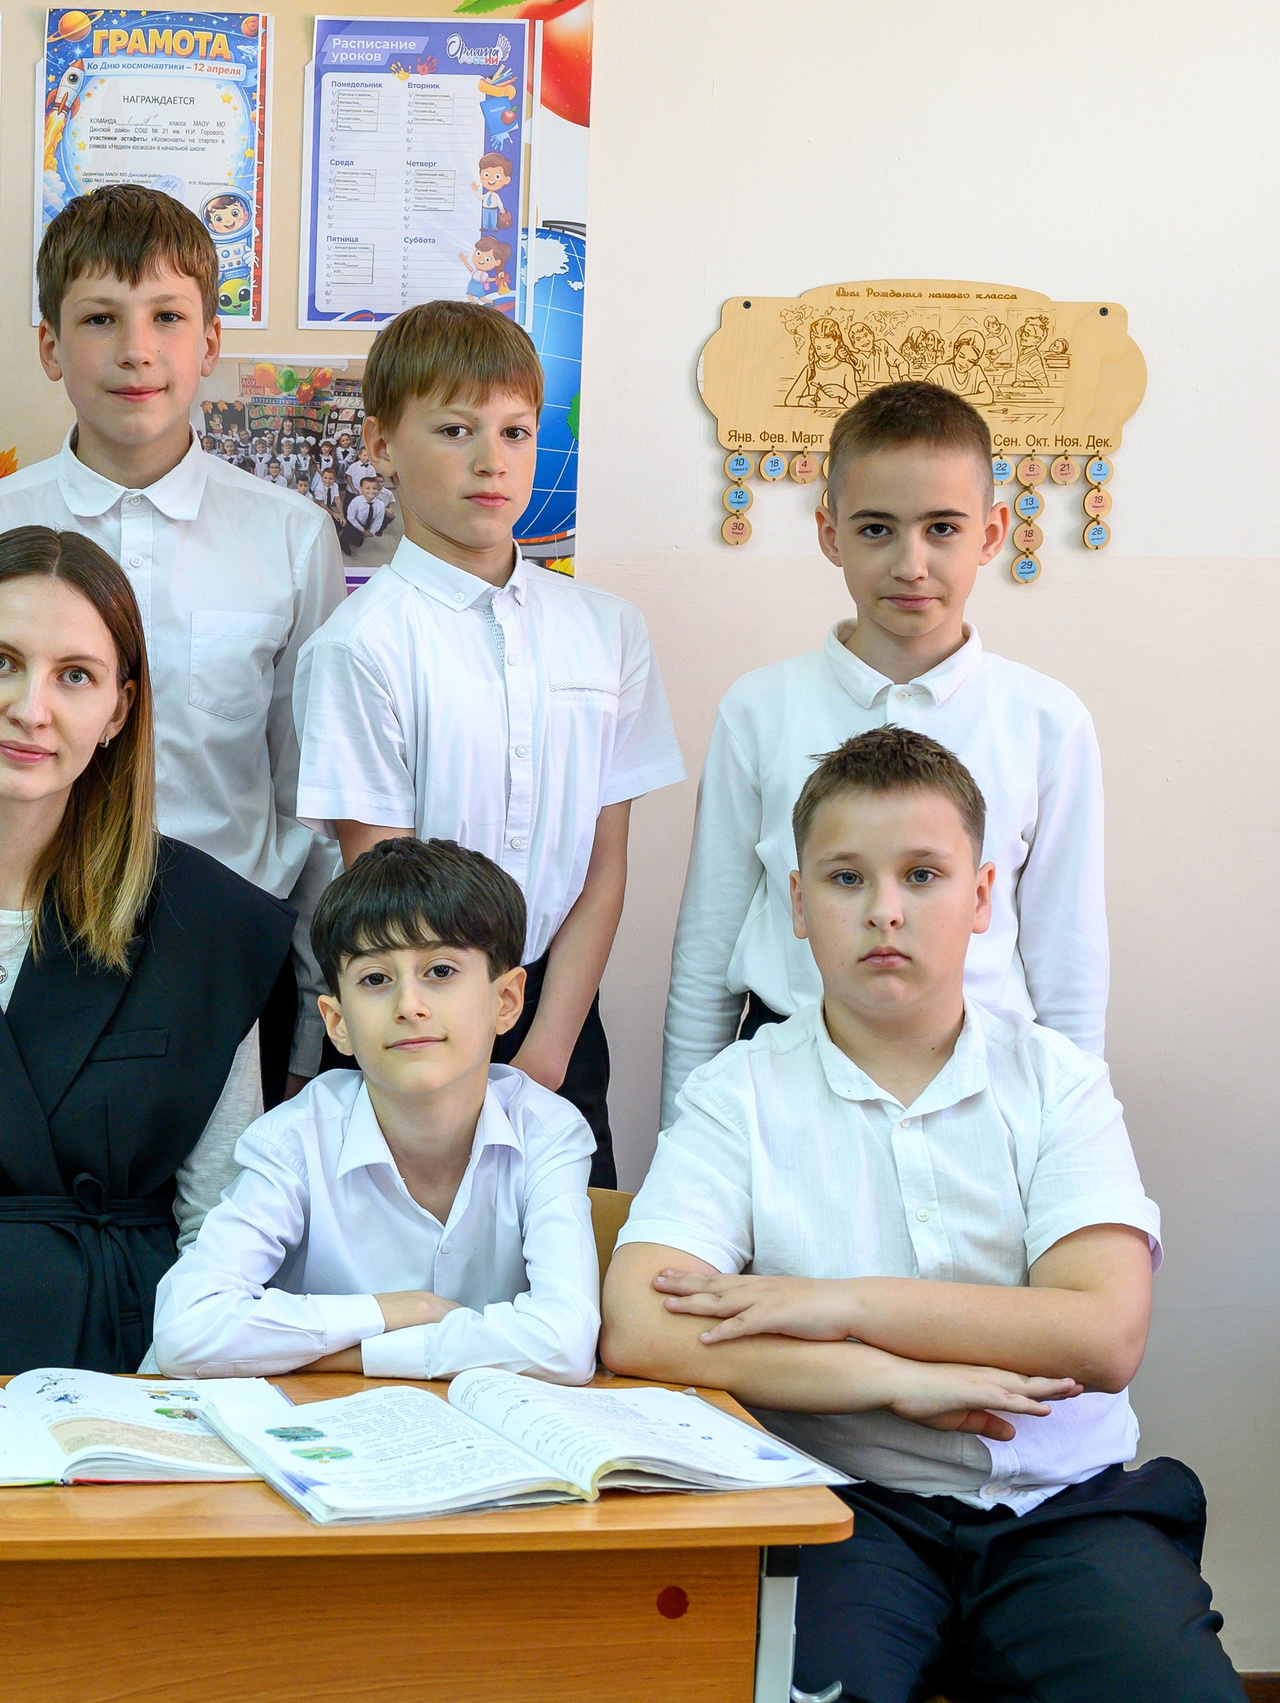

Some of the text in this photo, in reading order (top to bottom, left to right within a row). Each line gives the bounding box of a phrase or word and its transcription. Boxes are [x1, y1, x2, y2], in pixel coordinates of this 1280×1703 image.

[92, 28, 232, 61] ГРАМОТА
[332, 37, 416, 49] Расписание
[447, 35, 499, 60] Орлята
[331, 52, 381, 63] уроков
[87, 62, 98, 70] Ко
[99, 61, 120, 71] Дню
[121, 62, 184, 70] космонавтики
[206, 66, 241, 76] апреля
[122, 95, 194, 106] НАГРАЖДАЕТСЯ
[89, 117, 117, 125] КОМАНДА
[329, 158, 353, 166] Среда
[326, 235, 359, 244] Пятница
[403, 236, 435, 244] Суббота
[835, 286, 860, 297] Дни
[865, 287, 922, 298] Рождения
[727, 429, 824, 448] Янв. Фев. Март
[993, 433, 1112, 450] Сен. Окт. Ноя. Дек.
[735, 458, 744, 466] 10
[770, 459, 779, 467] 18
[996, 463, 1007, 471] 22
[1029, 464, 1035, 472] 6
[1060, 463, 1070, 472] 21
[734, 491, 743, 499] 12
[1024, 498, 1034, 506] 13
[1094, 496, 1103, 504] 19
[732, 523, 744, 531] 30
[1092, 527, 1103, 535] 26
[1024, 530, 1033, 538] 18
[1021, 561, 1033, 569] 29
